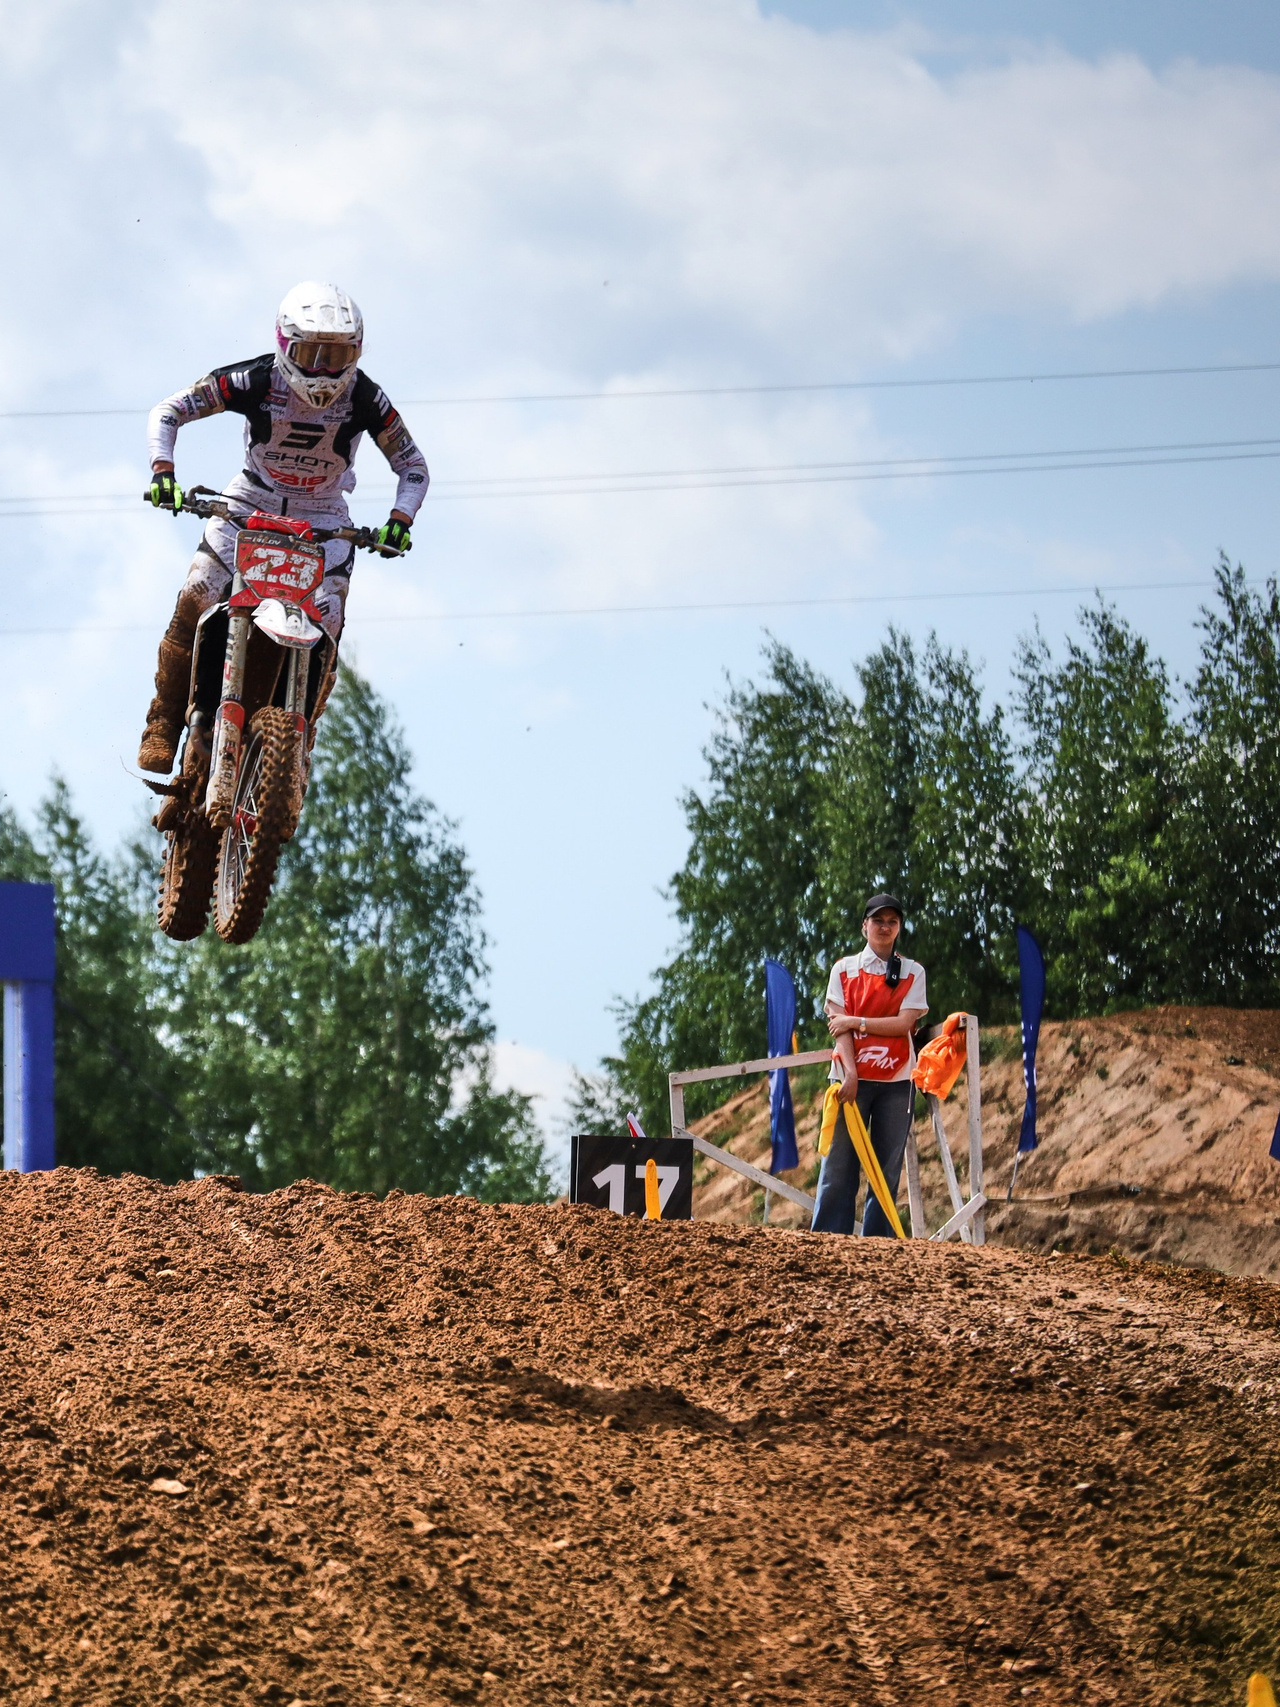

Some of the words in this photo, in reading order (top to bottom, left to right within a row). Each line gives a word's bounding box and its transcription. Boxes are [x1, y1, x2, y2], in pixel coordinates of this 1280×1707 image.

[264, 451, 335, 469] SHOT
[244, 548, 319, 590] 23
[591, 1163, 680, 1221] 17
